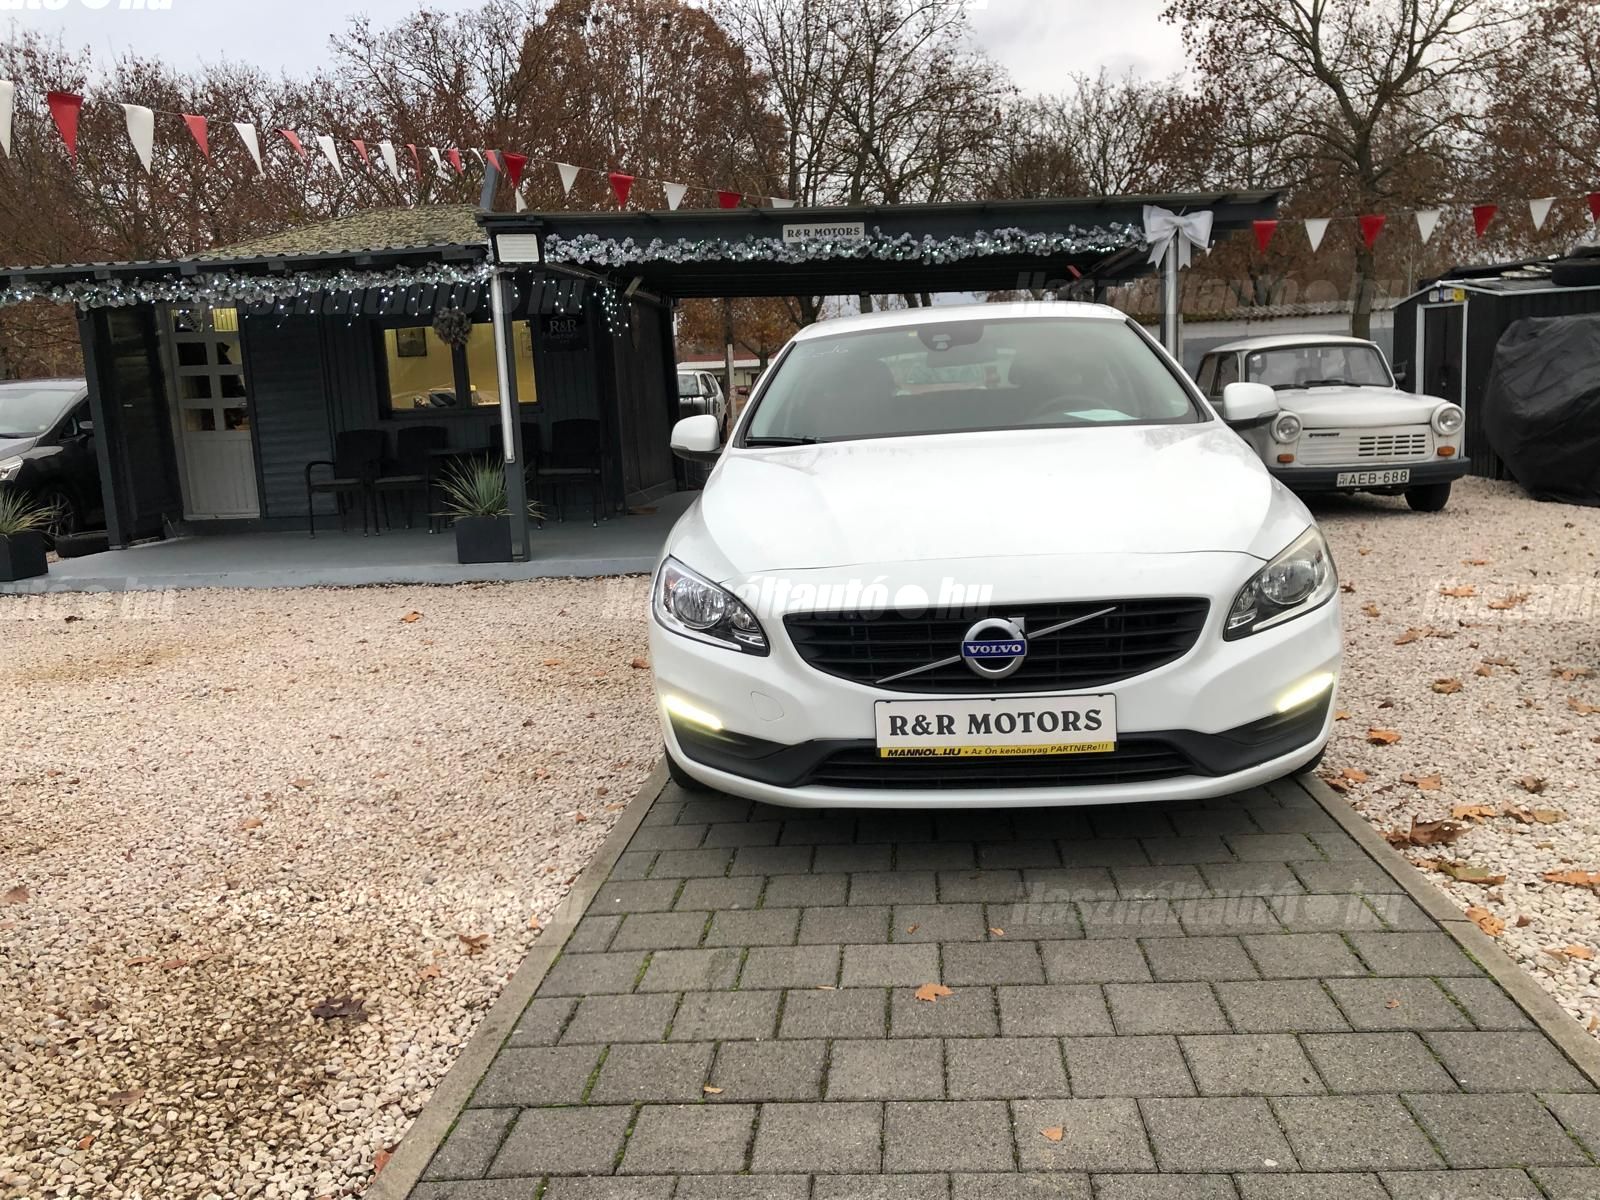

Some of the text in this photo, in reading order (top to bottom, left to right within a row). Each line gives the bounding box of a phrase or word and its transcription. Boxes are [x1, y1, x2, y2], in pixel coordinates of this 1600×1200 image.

[787, 227, 861, 238] R&R MOTORS
[1348, 470, 1408, 485] AEB-688
[967, 644, 1022, 654] VOLVO
[888, 708, 1103, 736] R&R MOTORS
[887, 747, 962, 757] MANNOL.HU
